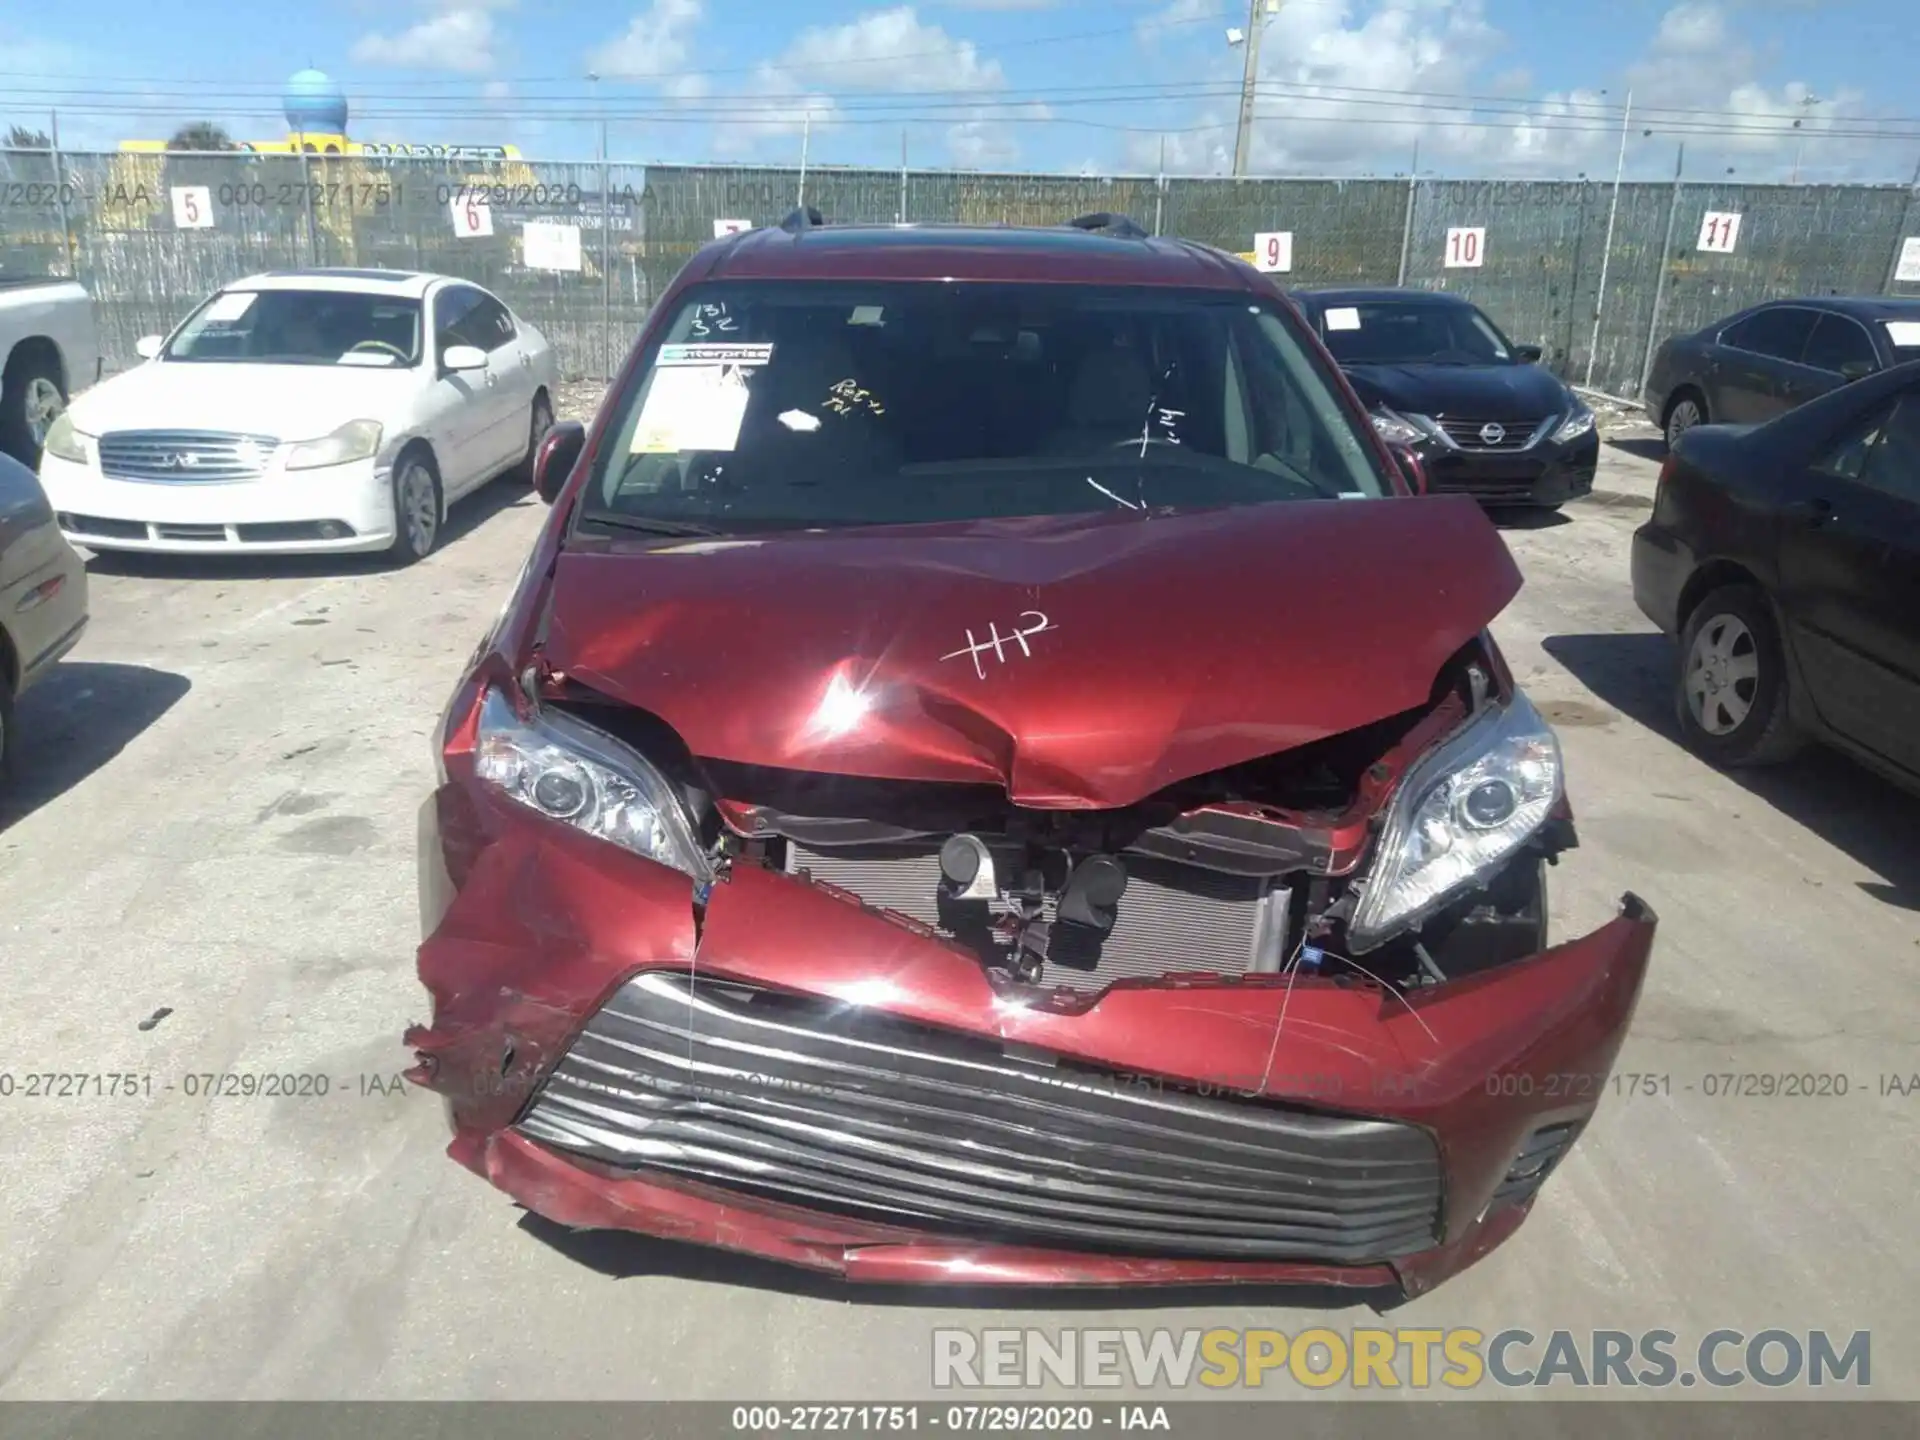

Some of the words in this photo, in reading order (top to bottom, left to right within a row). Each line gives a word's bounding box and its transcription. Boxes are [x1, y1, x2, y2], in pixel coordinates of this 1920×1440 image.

[184, 193, 199, 223] 5
[466, 200, 480, 231] 6
[1451, 232, 1477, 262] 10
[1707, 217, 1733, 249] 11
[1267, 237, 1279, 267] 9
